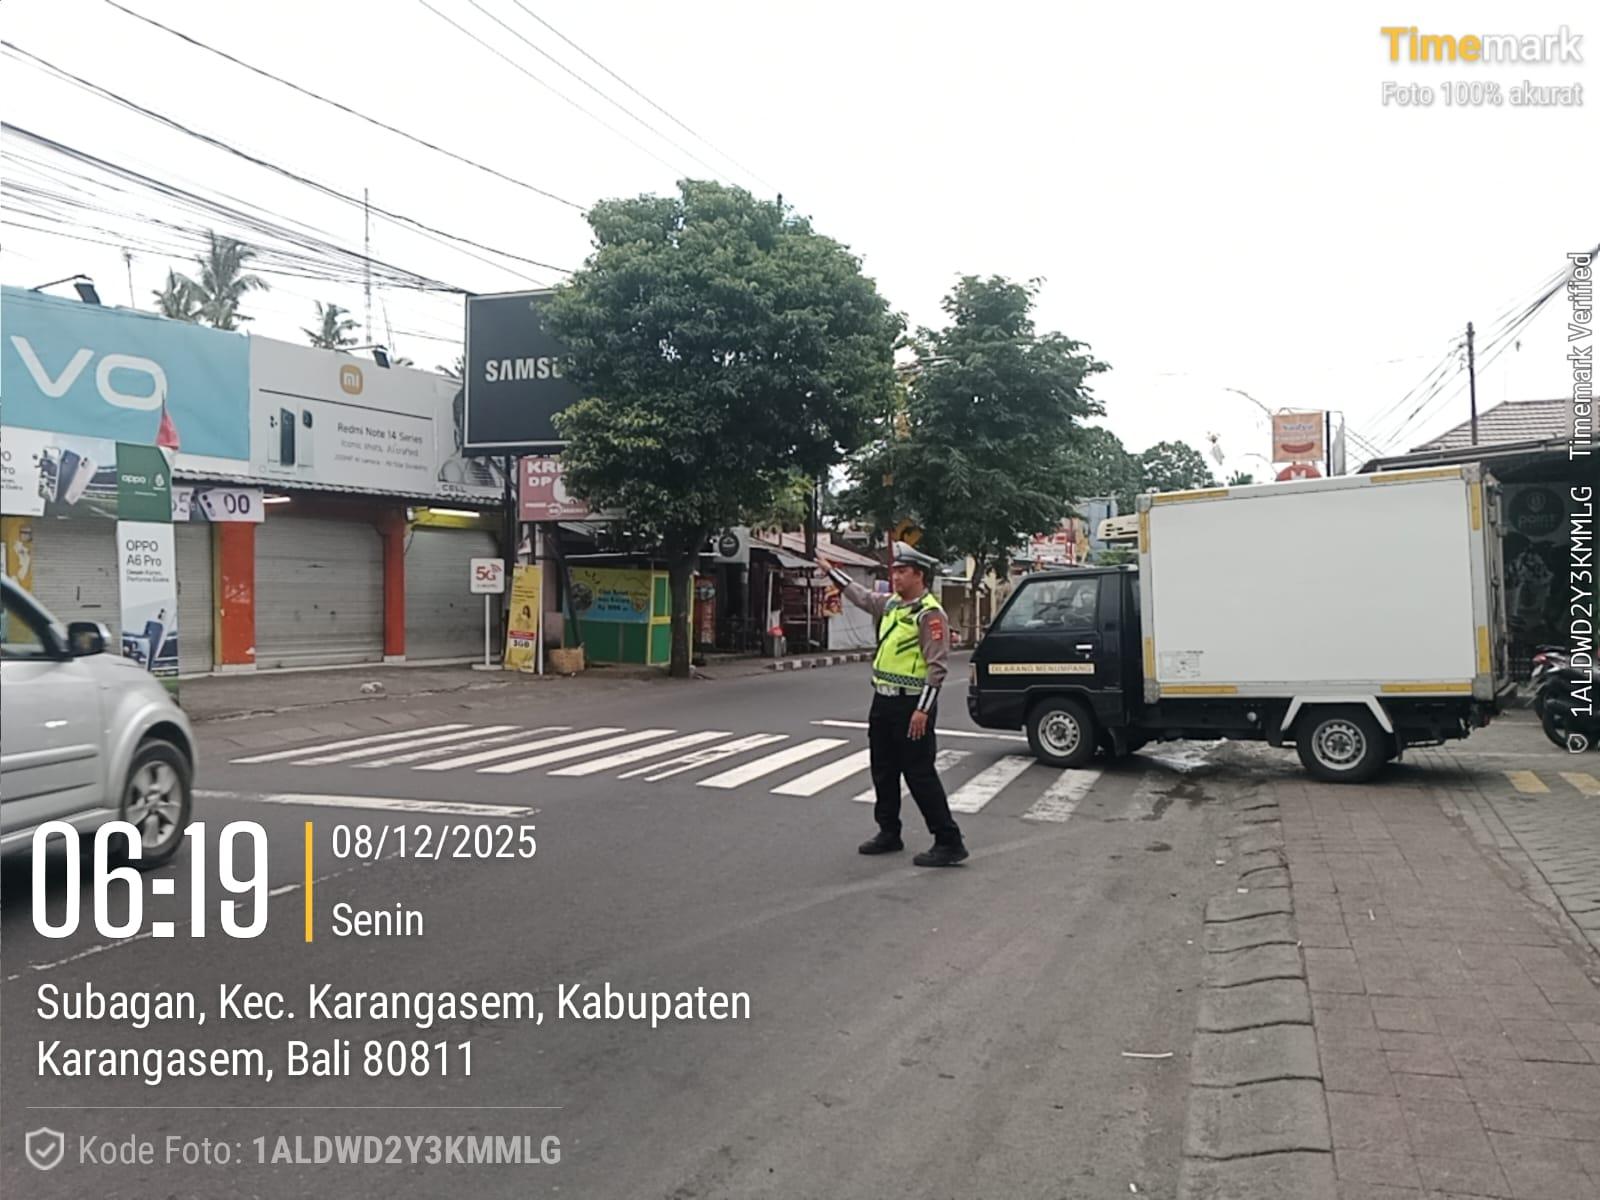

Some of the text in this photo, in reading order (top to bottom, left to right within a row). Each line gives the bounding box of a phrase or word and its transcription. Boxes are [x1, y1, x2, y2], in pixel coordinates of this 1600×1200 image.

[337, 422, 423, 445] Redmi Note 14 Series
[528, 476, 552, 487] DP
[442, 484, 466, 493] CELL
[126, 539, 158, 552] OPPO
[126, 554, 162, 567] A6 Pro
[476, 566, 496, 581] 5G
